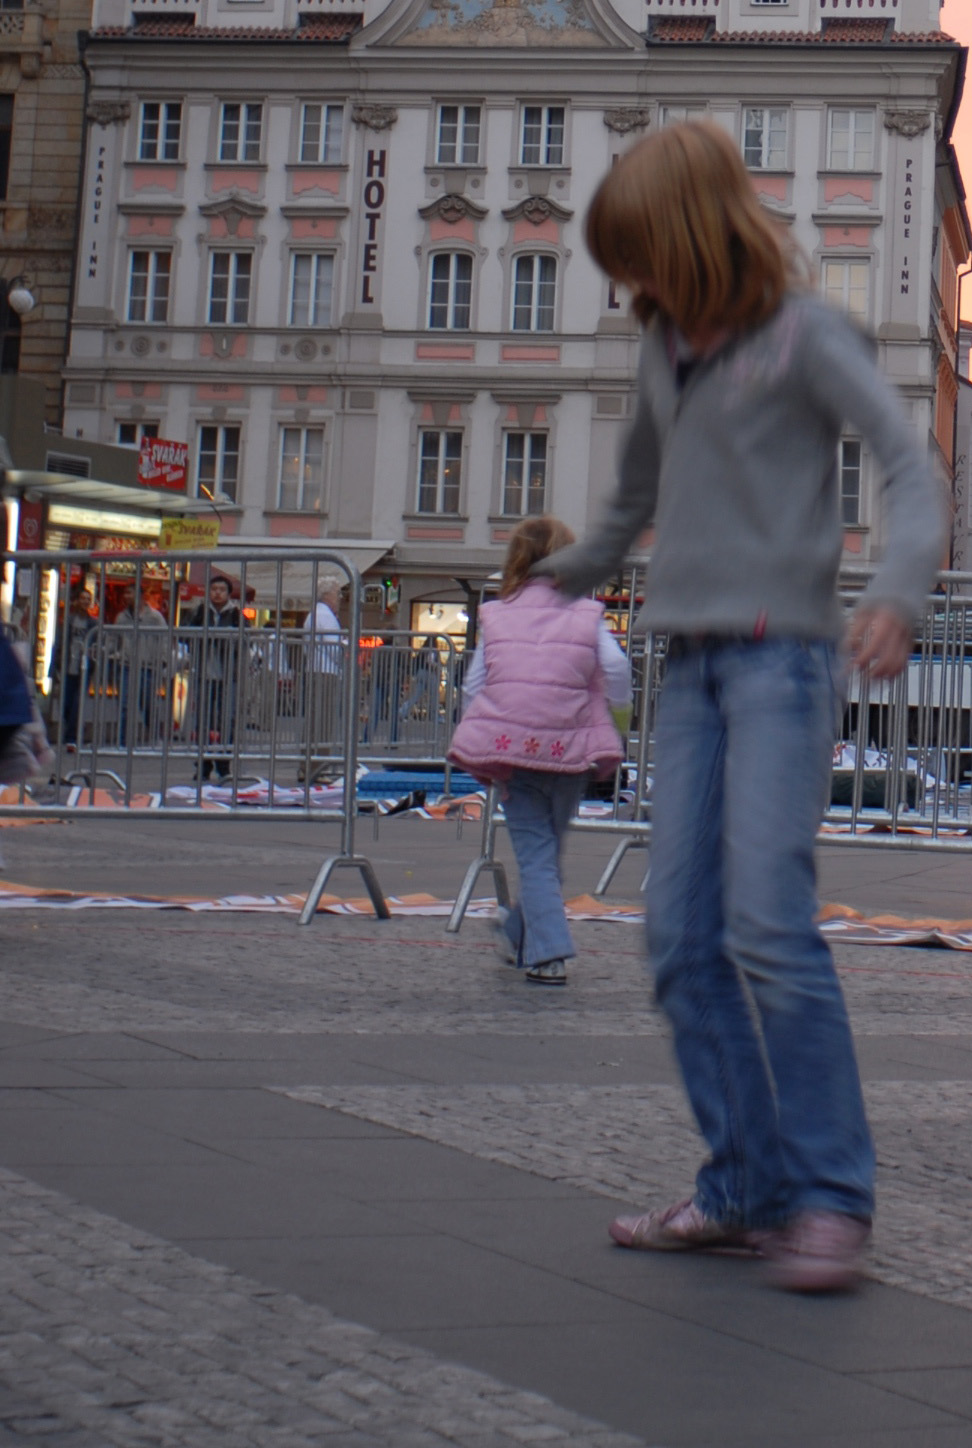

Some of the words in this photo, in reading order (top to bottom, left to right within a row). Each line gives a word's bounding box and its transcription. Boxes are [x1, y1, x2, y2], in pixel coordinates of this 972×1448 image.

[93, 146, 106, 225] PRAGUE
[904, 158, 913, 239] PRAGUE
[88, 241, 98, 278] INN
[361, 149, 387, 304] HOTEL
[900, 256, 909, 294] INN
